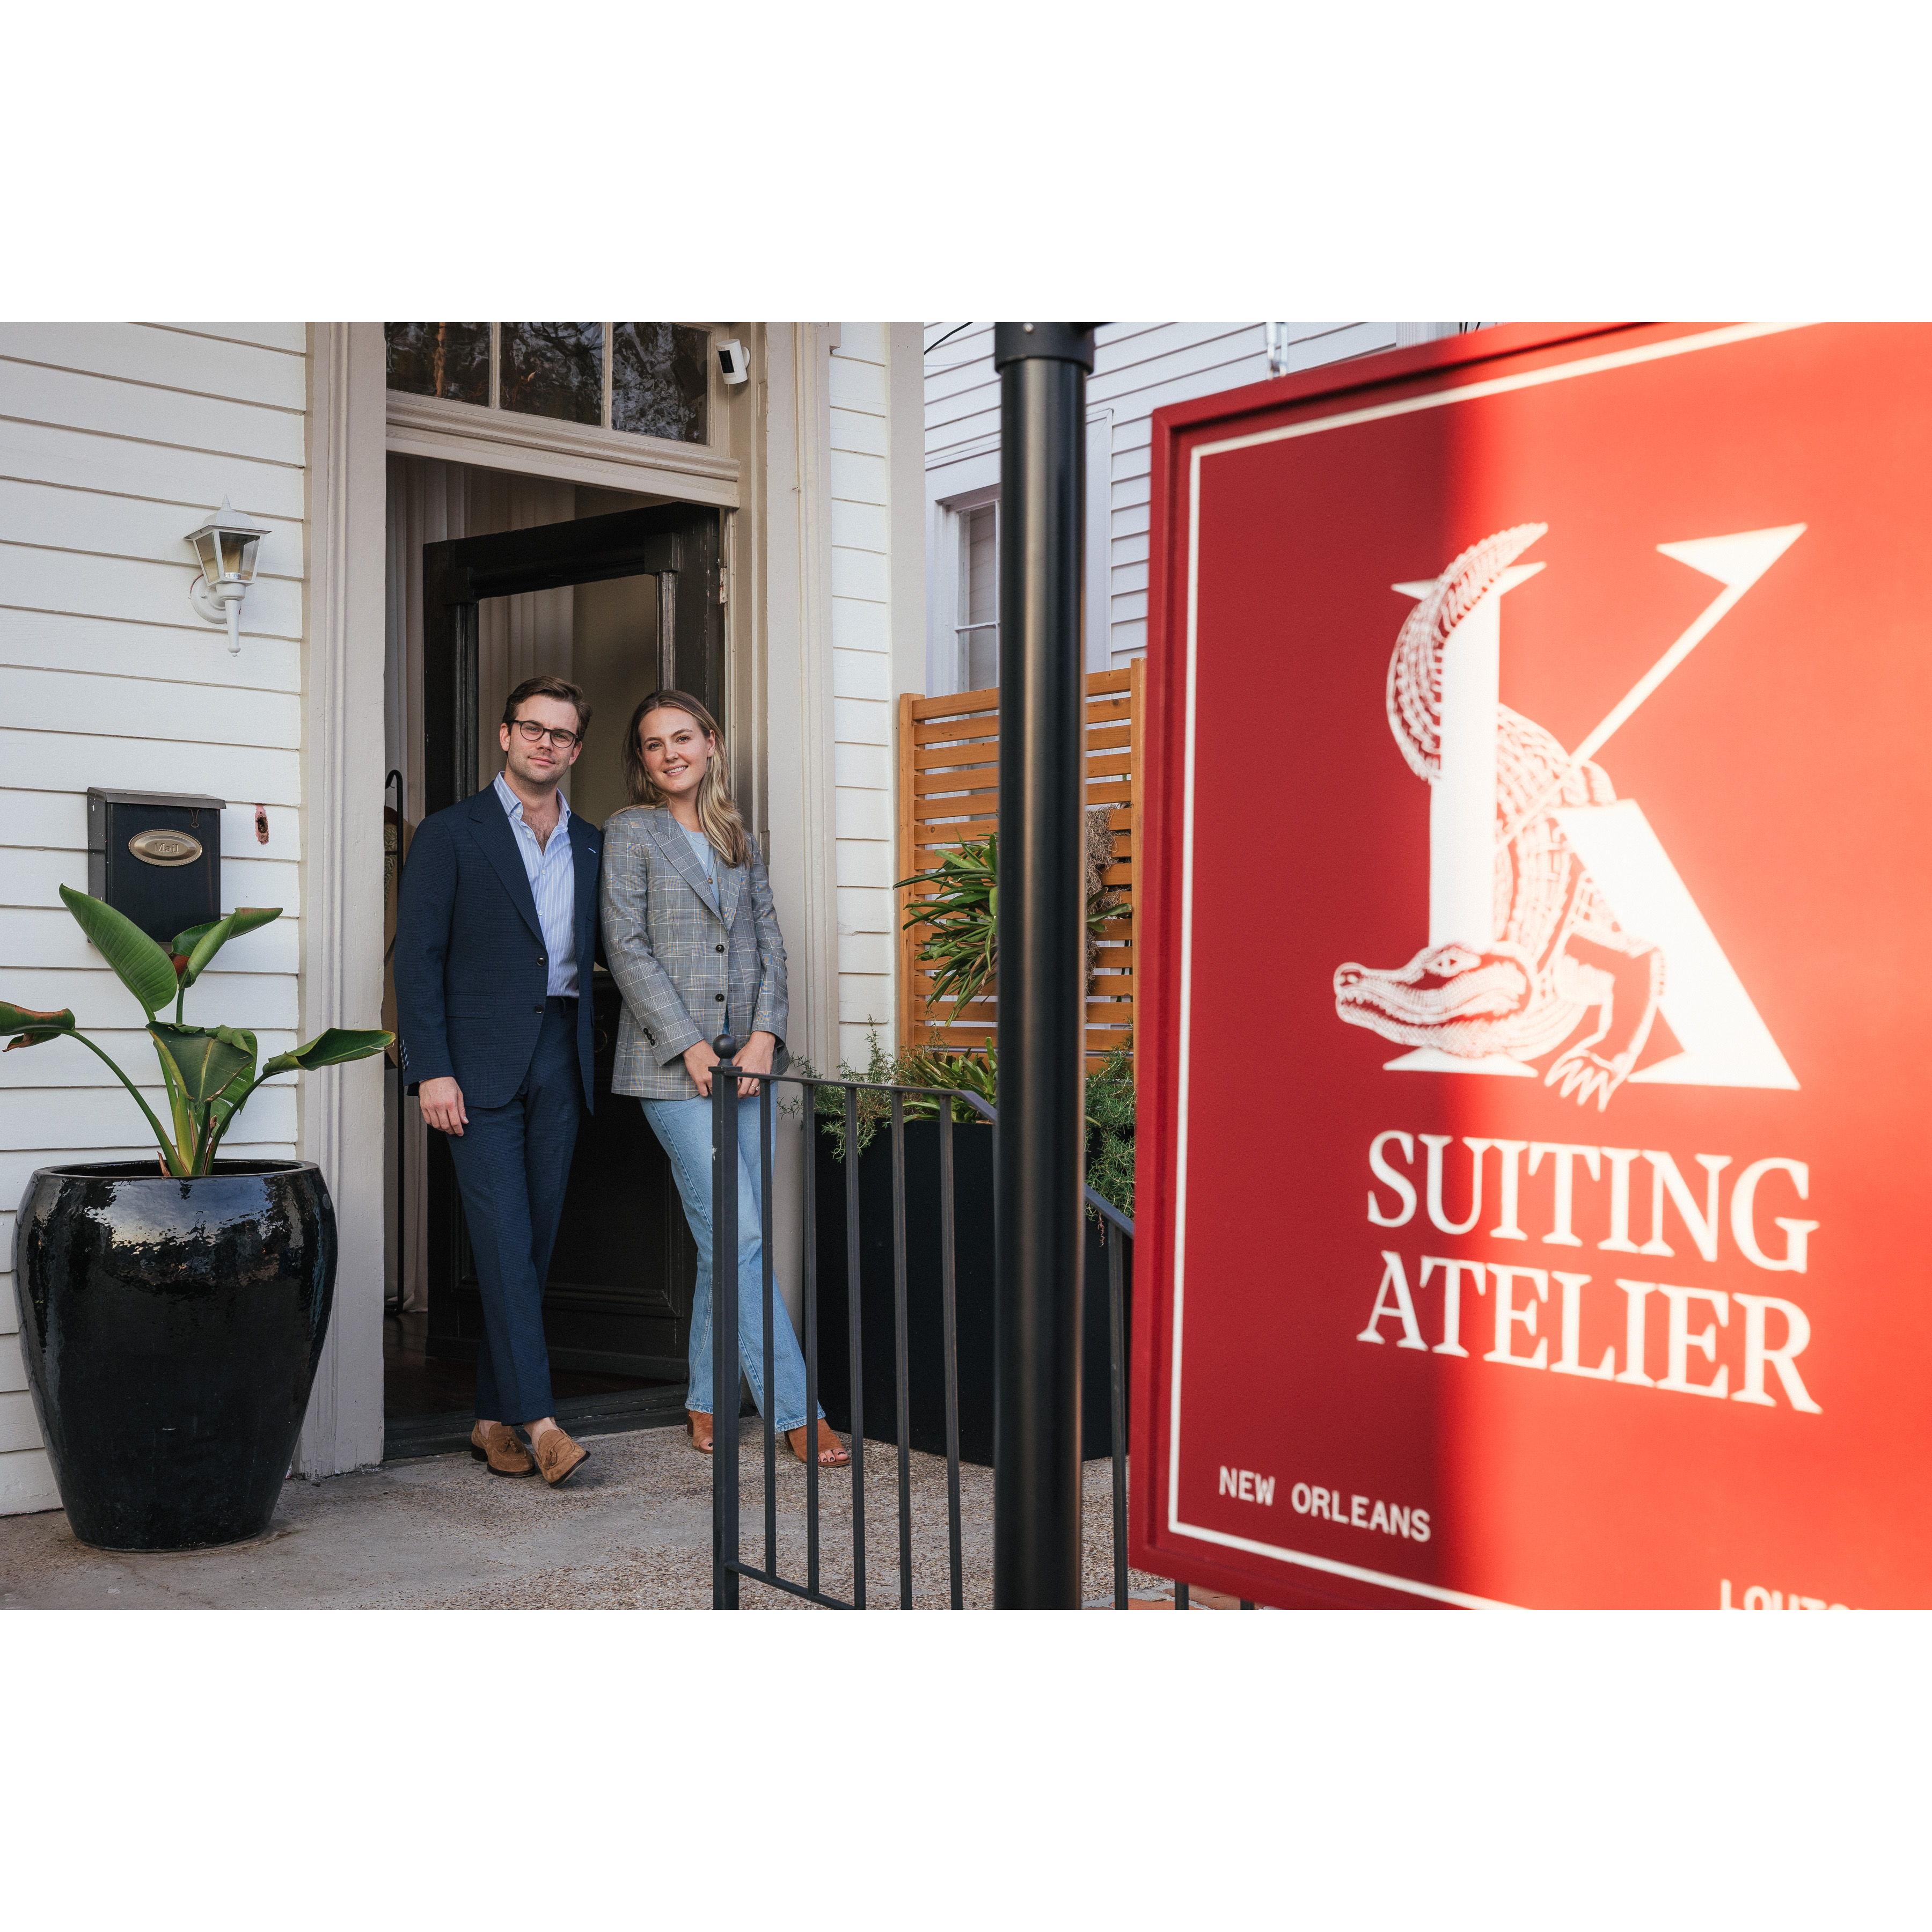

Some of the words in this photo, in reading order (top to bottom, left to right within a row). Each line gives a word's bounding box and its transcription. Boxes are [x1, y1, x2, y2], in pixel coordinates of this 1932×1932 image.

[154, 843, 179, 853] Mail
[1382, 523, 1809, 1092] K
[1367, 1130, 1820, 1274] SUITING
[1356, 1250, 1823, 1415] ATELIER
[1218, 1465, 1276, 1506] NEW
[1291, 1482, 1431, 1542] ORLEANS
